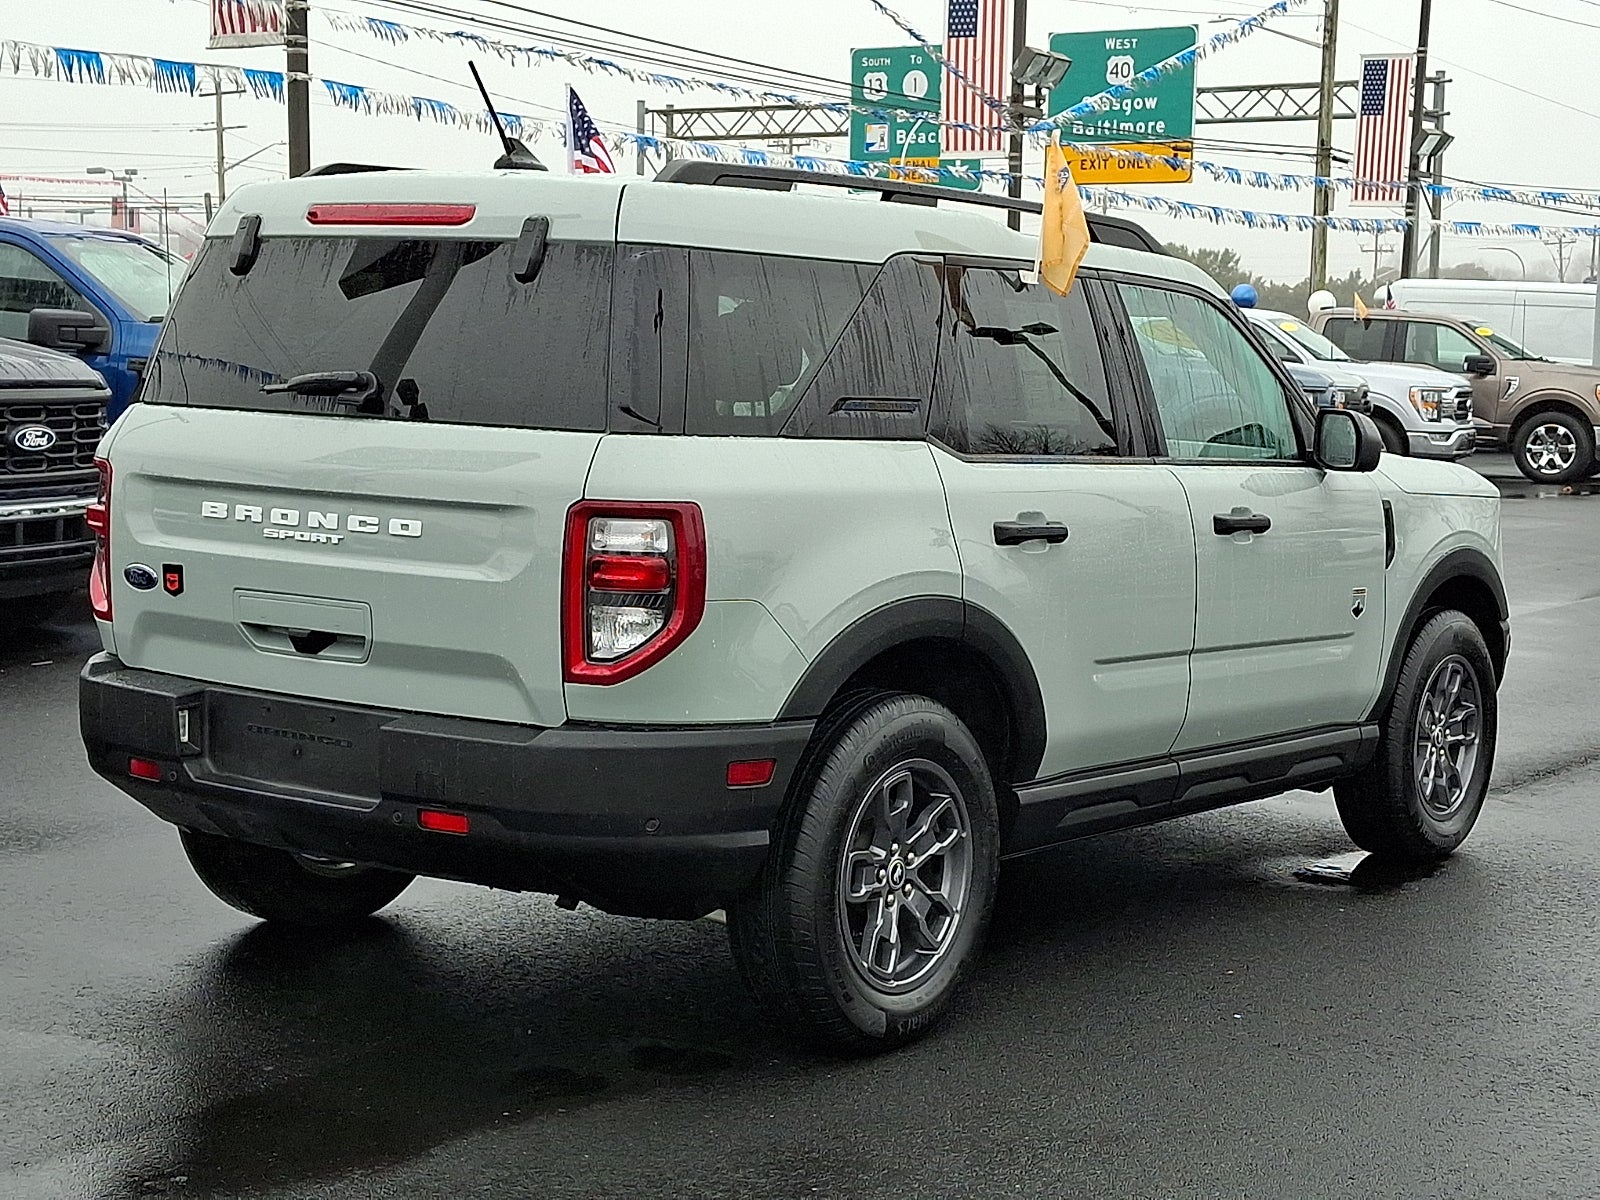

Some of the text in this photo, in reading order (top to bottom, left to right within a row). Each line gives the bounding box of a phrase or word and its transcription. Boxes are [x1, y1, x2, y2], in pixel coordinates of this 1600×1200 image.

[1105, 37, 1138, 50] WEST
[861, 57, 891, 67] SOUTH
[910, 54, 923, 64] TO
[1109, 61, 1131, 79] 40
[868, 77, 883, 94] 13
[913, 77, 918, 93] 1
[1072, 119, 1166, 136] Baltimore
[894, 160, 932, 169] SGNAL
[1080, 158, 1153, 170] EXIT ONLY
[23, 430, 49, 447] Ford
[201, 501, 423, 538] BRONCO
[263, 528, 345, 545] SPORT
